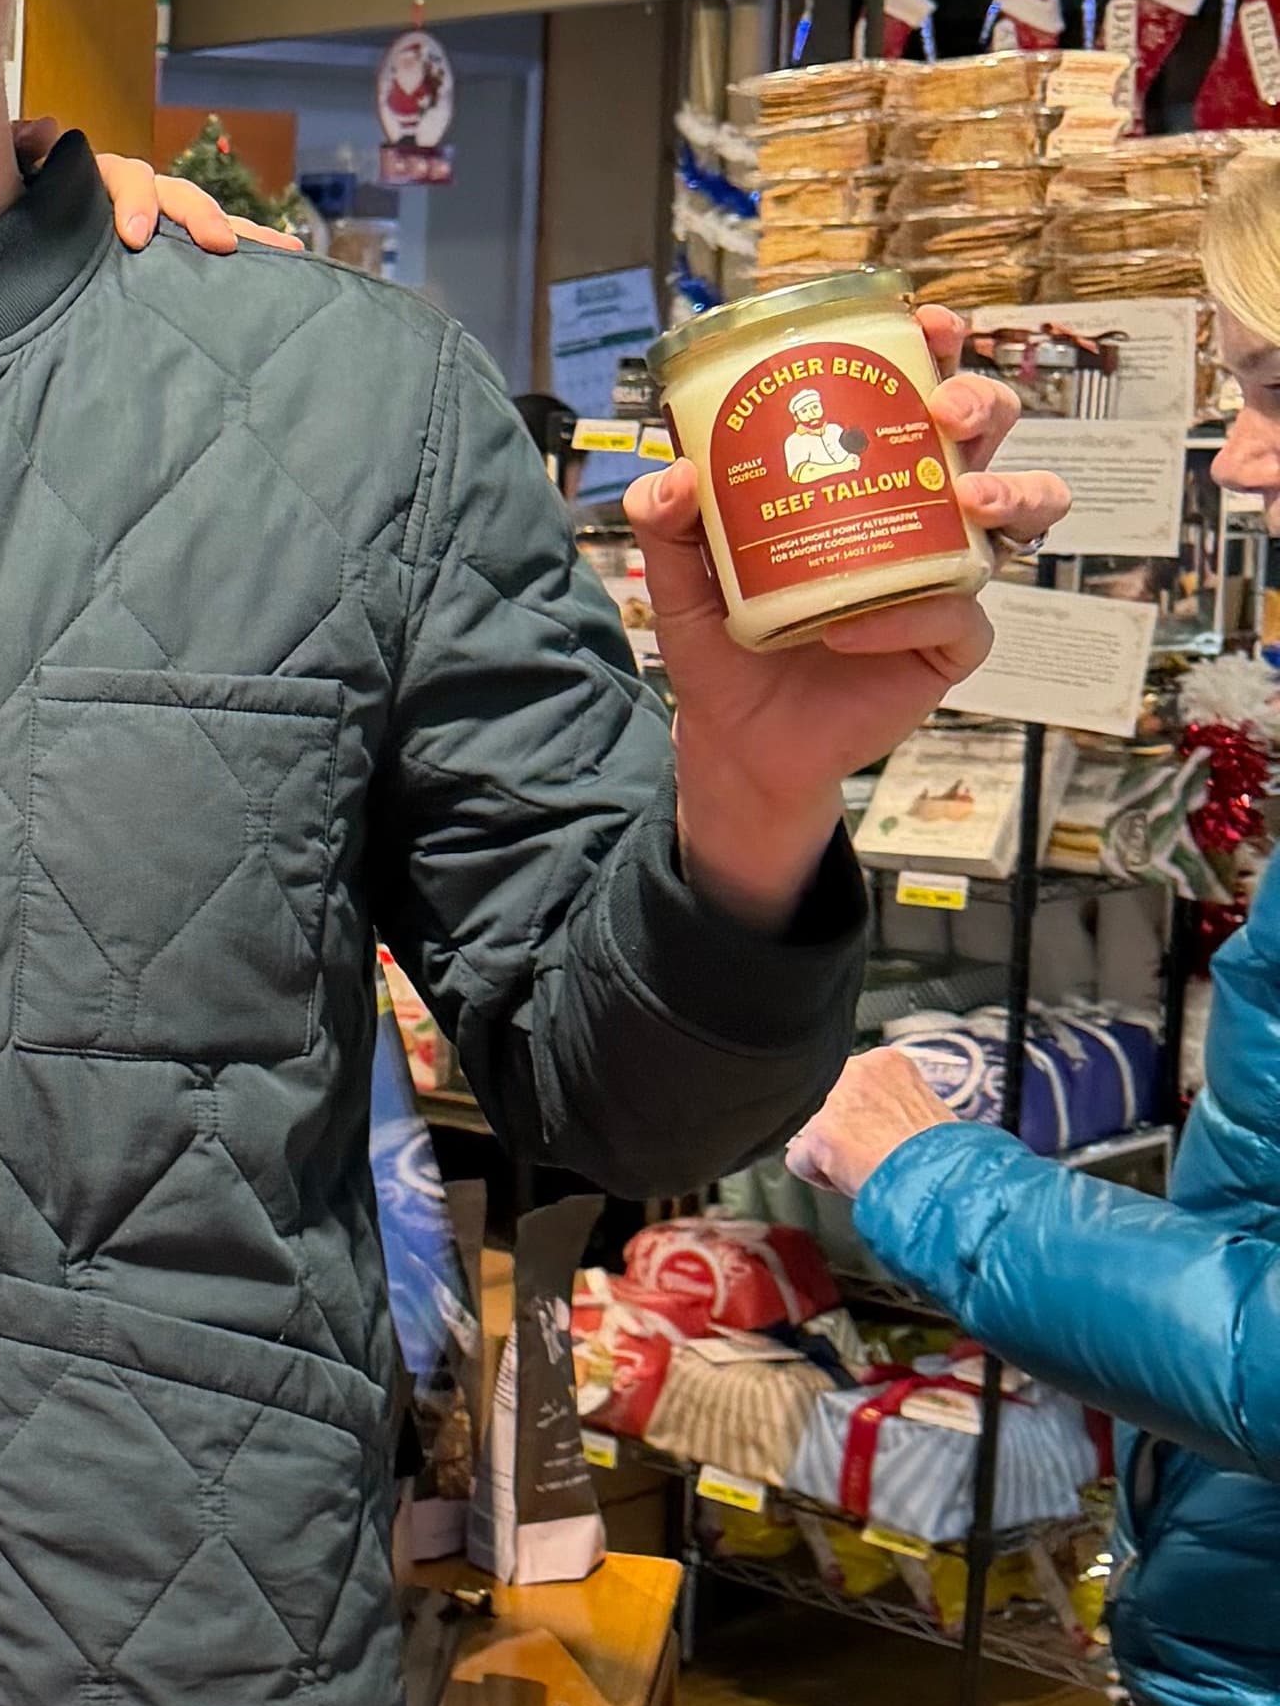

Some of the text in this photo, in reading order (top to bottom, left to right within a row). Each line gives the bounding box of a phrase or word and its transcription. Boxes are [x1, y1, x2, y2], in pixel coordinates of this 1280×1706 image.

[727, 357, 899, 432] BUTCHER BEN'S
[728, 457, 762, 475] LOCALLY
[728, 467, 766, 485] SOURCED
[761, 470, 911, 521] BEEF TALLOW
